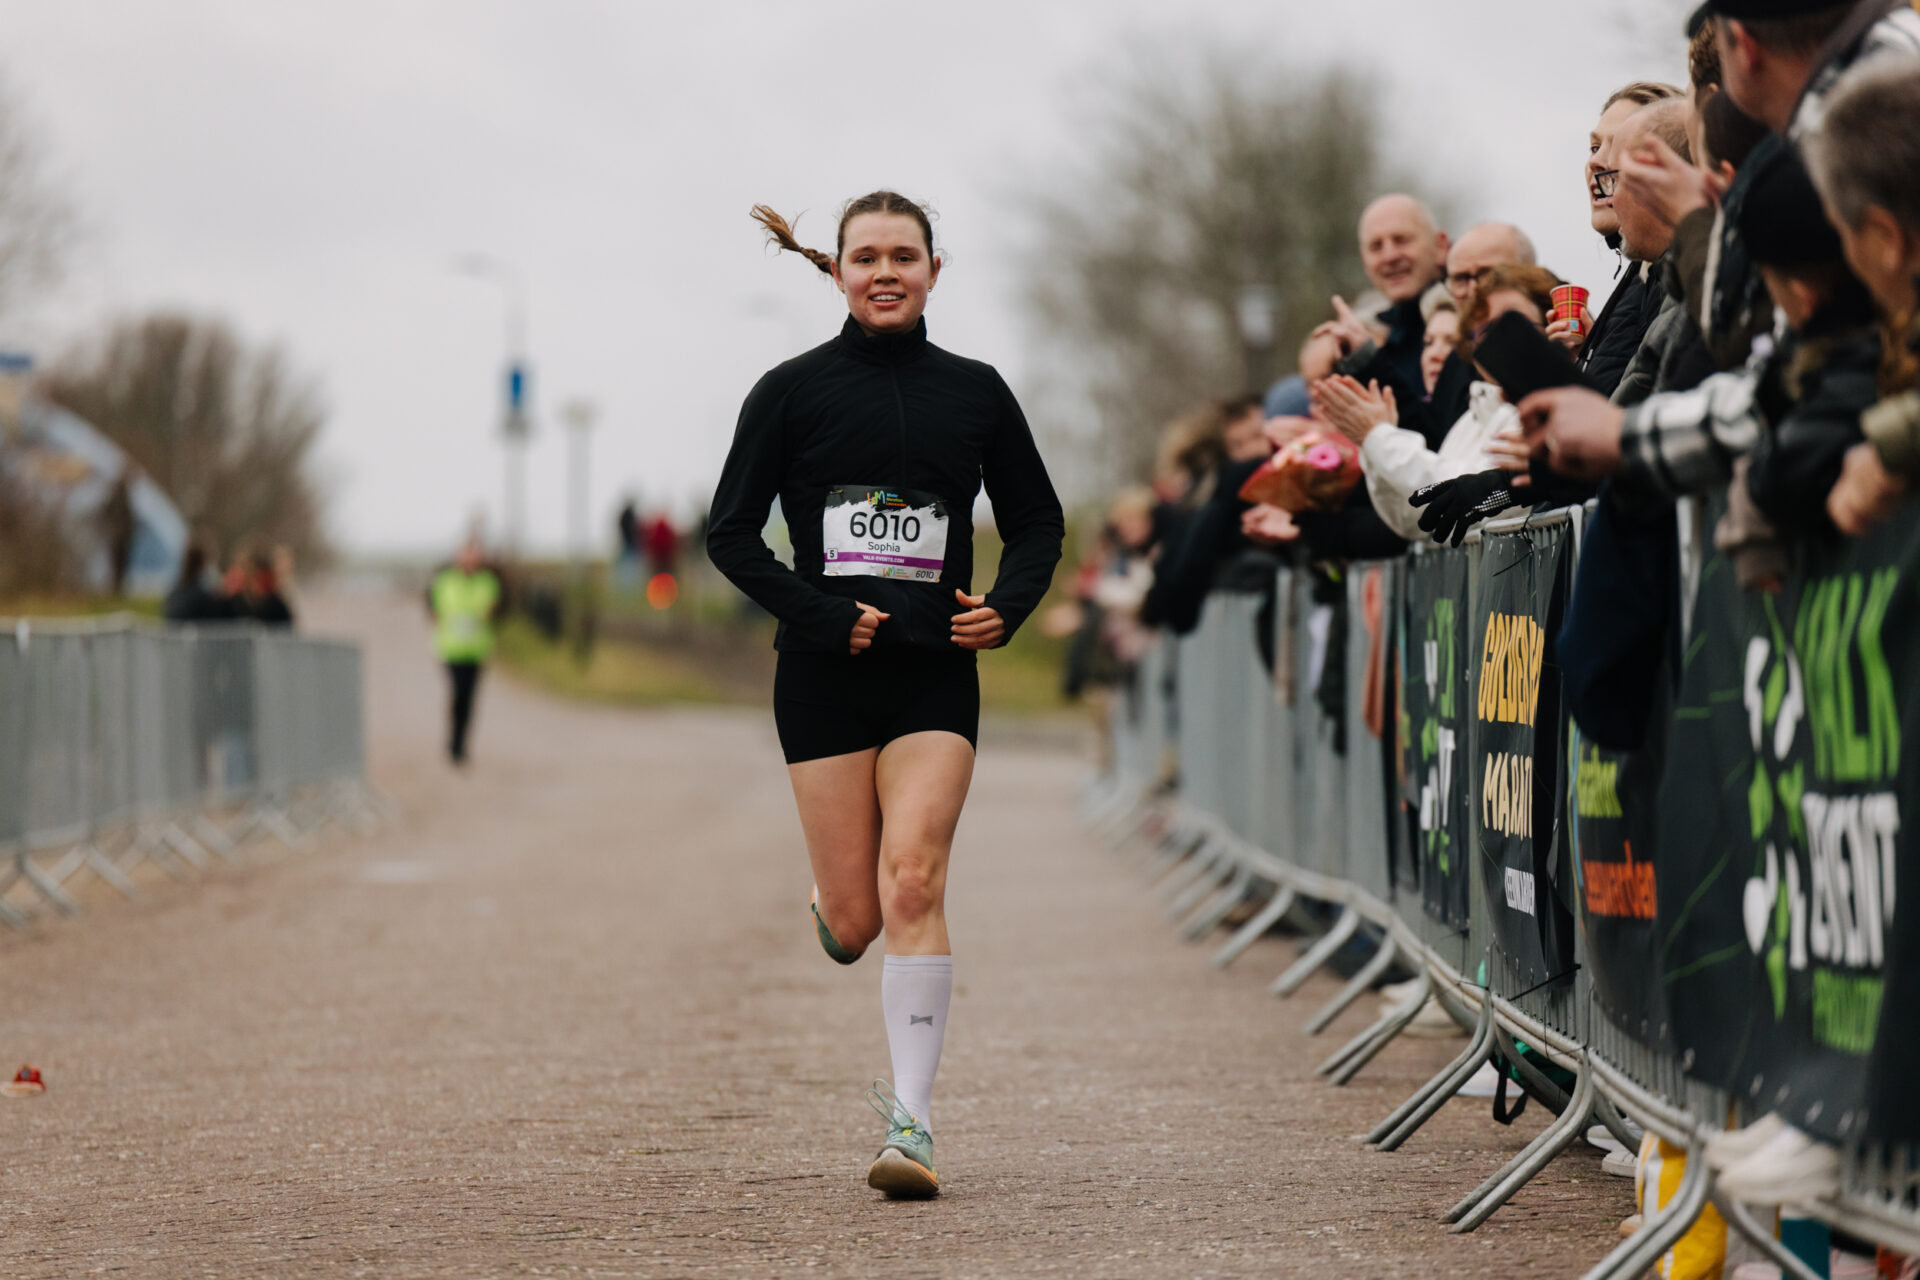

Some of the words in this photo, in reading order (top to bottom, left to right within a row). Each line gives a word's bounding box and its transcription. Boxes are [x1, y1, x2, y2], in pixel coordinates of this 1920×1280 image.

[849, 511, 921, 543] 6010
[867, 541, 901, 554] Sophia
[828, 549, 836, 559] 5
[915, 570, 935, 579] 6010
